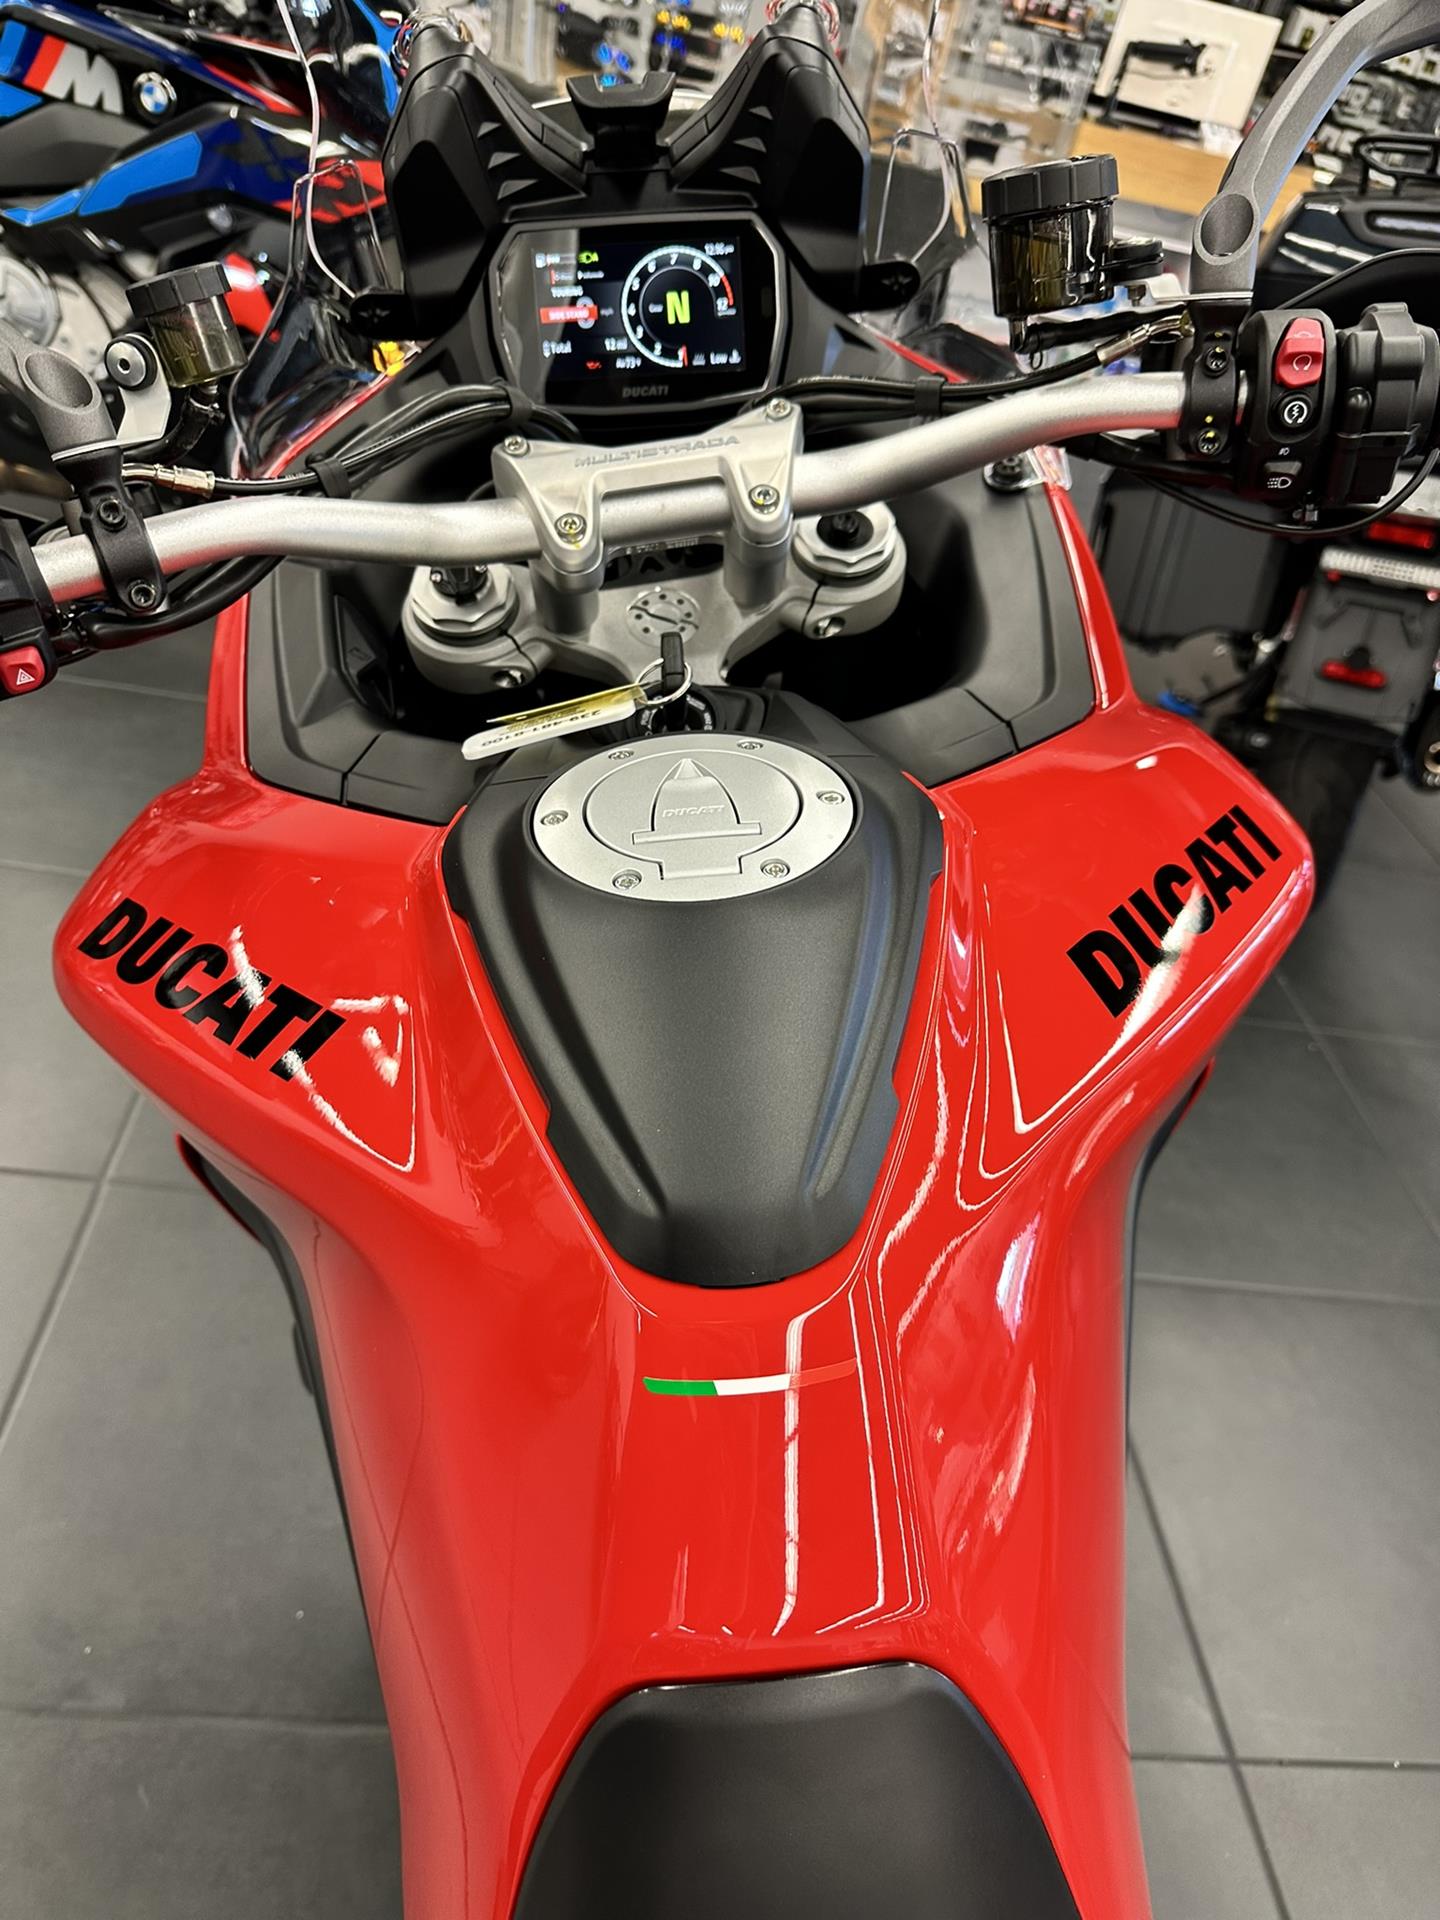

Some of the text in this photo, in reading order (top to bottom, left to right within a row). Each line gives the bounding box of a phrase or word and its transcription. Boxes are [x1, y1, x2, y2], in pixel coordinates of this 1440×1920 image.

[670, 253, 679, 265] 7
[631, 277, 641, 291] 5
[627, 302, 636, 317] 4
[665, 290, 691, 325] N
[551, 340, 572, 354] Total
[654, 341, 662, 356] 2
[709, 352, 728, 365] Low
[622, 384, 669, 398] DUCATI
[574, 435, 740, 468] MULTISTRADA
[662, 804, 725, 818] DUCATI
[1066, 804, 1282, 1018] DUCATI
[77, 897, 346, 1082] DUCATI
